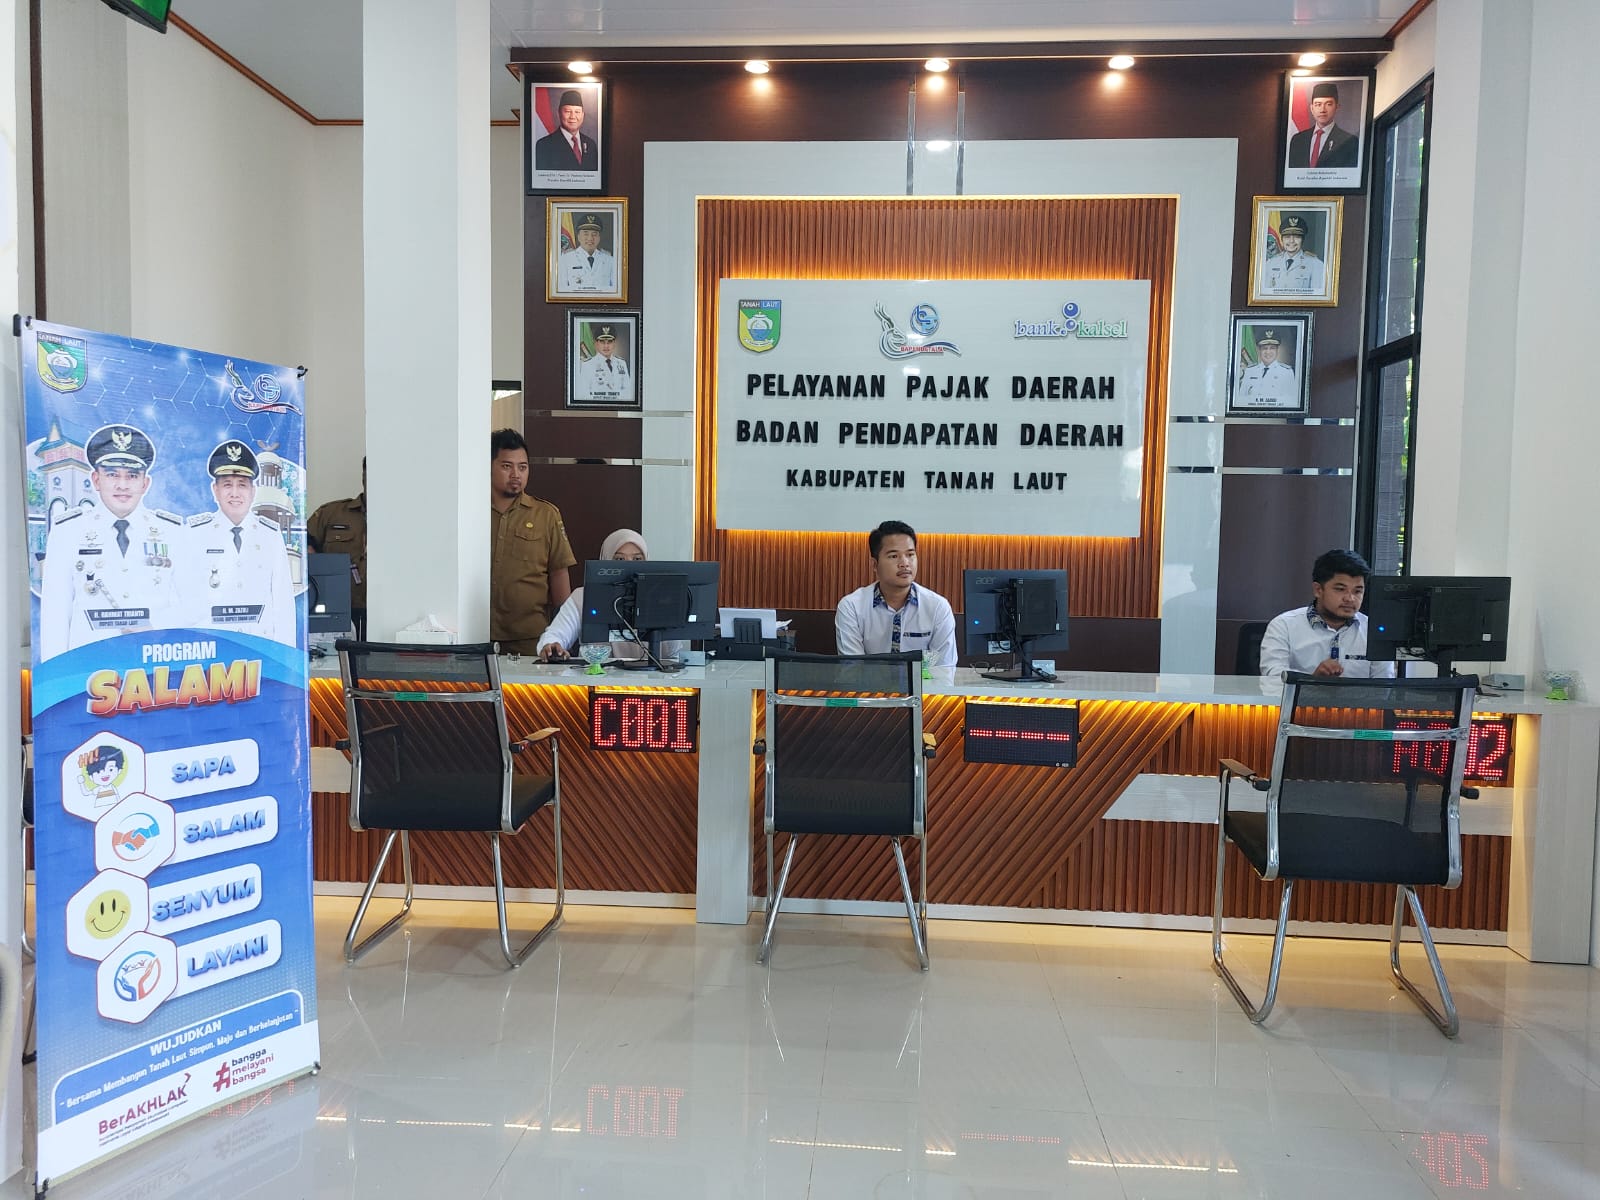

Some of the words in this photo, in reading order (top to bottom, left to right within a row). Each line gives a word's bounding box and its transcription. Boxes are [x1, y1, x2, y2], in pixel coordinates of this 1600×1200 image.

[1016, 319, 1059, 336] bank
[1078, 320, 1126, 337] kalsel
[747, 373, 885, 398] PELAYANAN
[906, 375, 990, 399] PAJAK
[1011, 376, 1115, 400] DAERAH
[736, 419, 819, 444] BADAN
[838, 423, 998, 447] PENDAPATAN
[1020, 423, 1124, 448] DAERAH
[786, 469, 905, 489] KABUPATEN
[924, 471, 995, 490] TANAH
[1013, 472, 1068, 491] LAUT
[597, 567, 625, 576] acer
[975, 576, 997, 585] acer
[142, 641, 217, 663] PROGRAM
[86, 659, 262, 717] SALAMI
[594, 697, 693, 749] C001
[171, 755, 236, 783] SAPA
[182, 809, 266, 844] SALAM
[152, 876, 256, 922] SENYUM
[186, 933, 269, 977] LAYANI
[150, 1019, 222, 1056] WUJUDKAN
[67, 1088, 102, 1108] Bersama
[103, 1068, 147, 1093] Membangun
[149, 1058, 170, 1073] Tanah
[171, 1051, 187, 1064] Laut
[217, 1034, 233, 1045] Maju
[235, 1029, 248, 1039] dan
[232, 1048, 267, 1066] bangga
[232, 1053, 274, 1076] melayani
[233, 1067, 267, 1085] bangsa
[98, 1080, 188, 1135] BerAKHLAK
